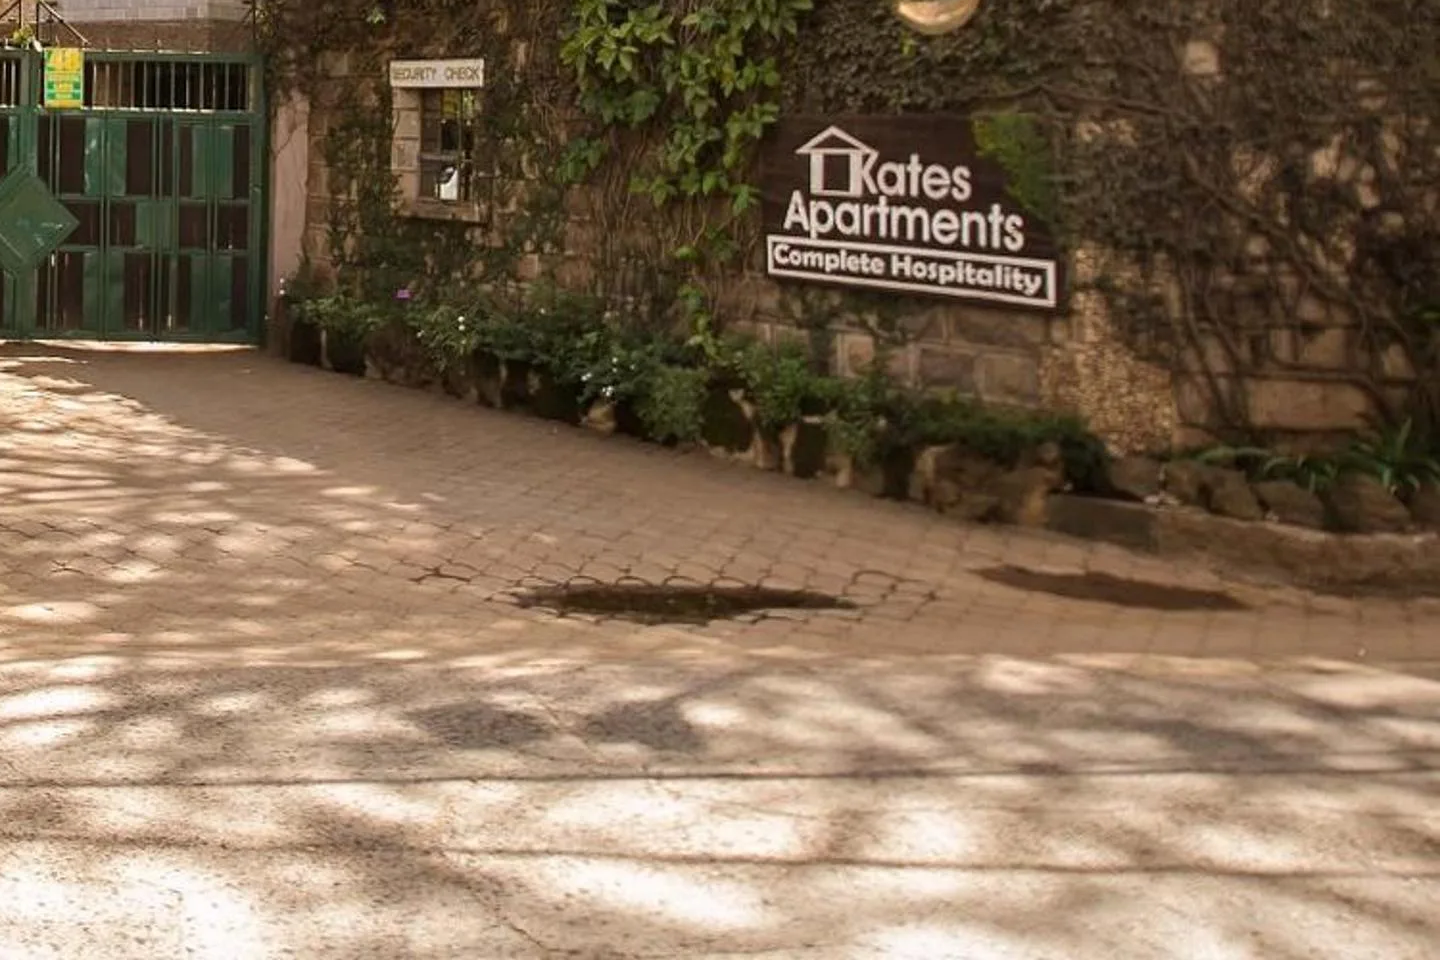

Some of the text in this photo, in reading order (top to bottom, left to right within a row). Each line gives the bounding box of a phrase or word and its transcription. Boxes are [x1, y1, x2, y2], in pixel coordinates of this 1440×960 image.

[849, 151, 972, 202] Kates
[783, 190, 1026, 252] Apartments
[773, 243, 1042, 296] Complete Hospitality
